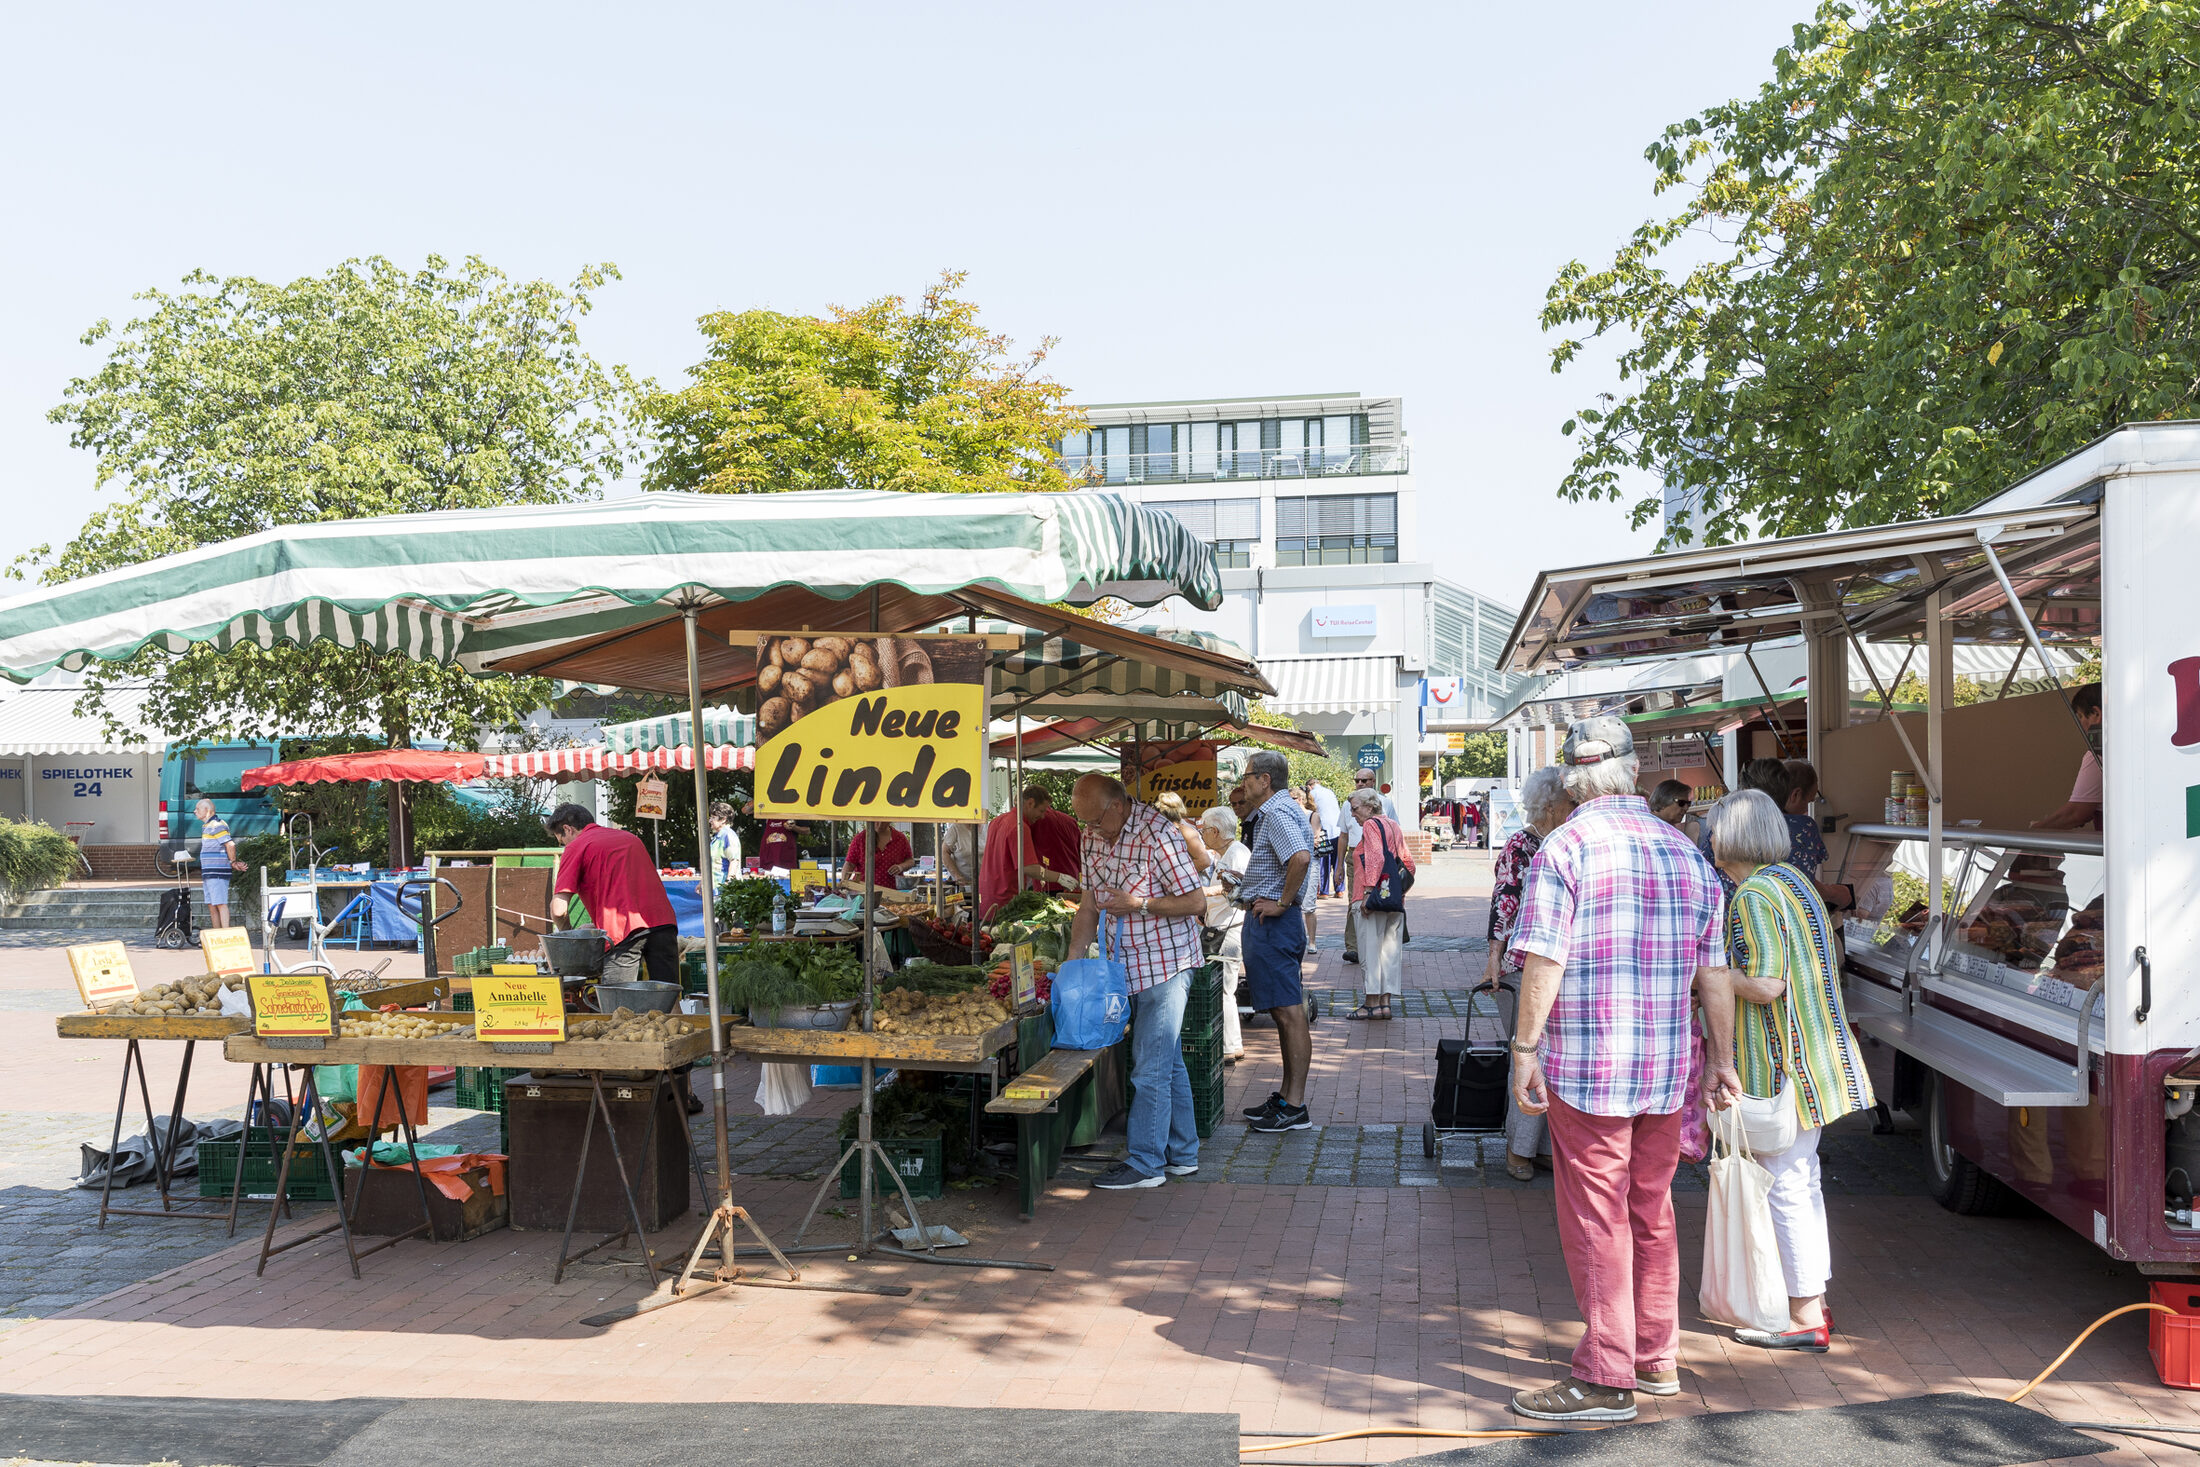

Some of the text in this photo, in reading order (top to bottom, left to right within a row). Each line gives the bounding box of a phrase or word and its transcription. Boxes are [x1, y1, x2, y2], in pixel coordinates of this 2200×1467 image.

[850, 696, 961, 739] Neue
[42, 768, 133, 779] SPIELOTHEK
[767, 742, 972, 808] Linda
[1149, 771, 1213, 792] frische
[73, 782, 102, 797] 24
[504, 981, 527, 989] Neue
[489, 991, 547, 1001] Annabelle
